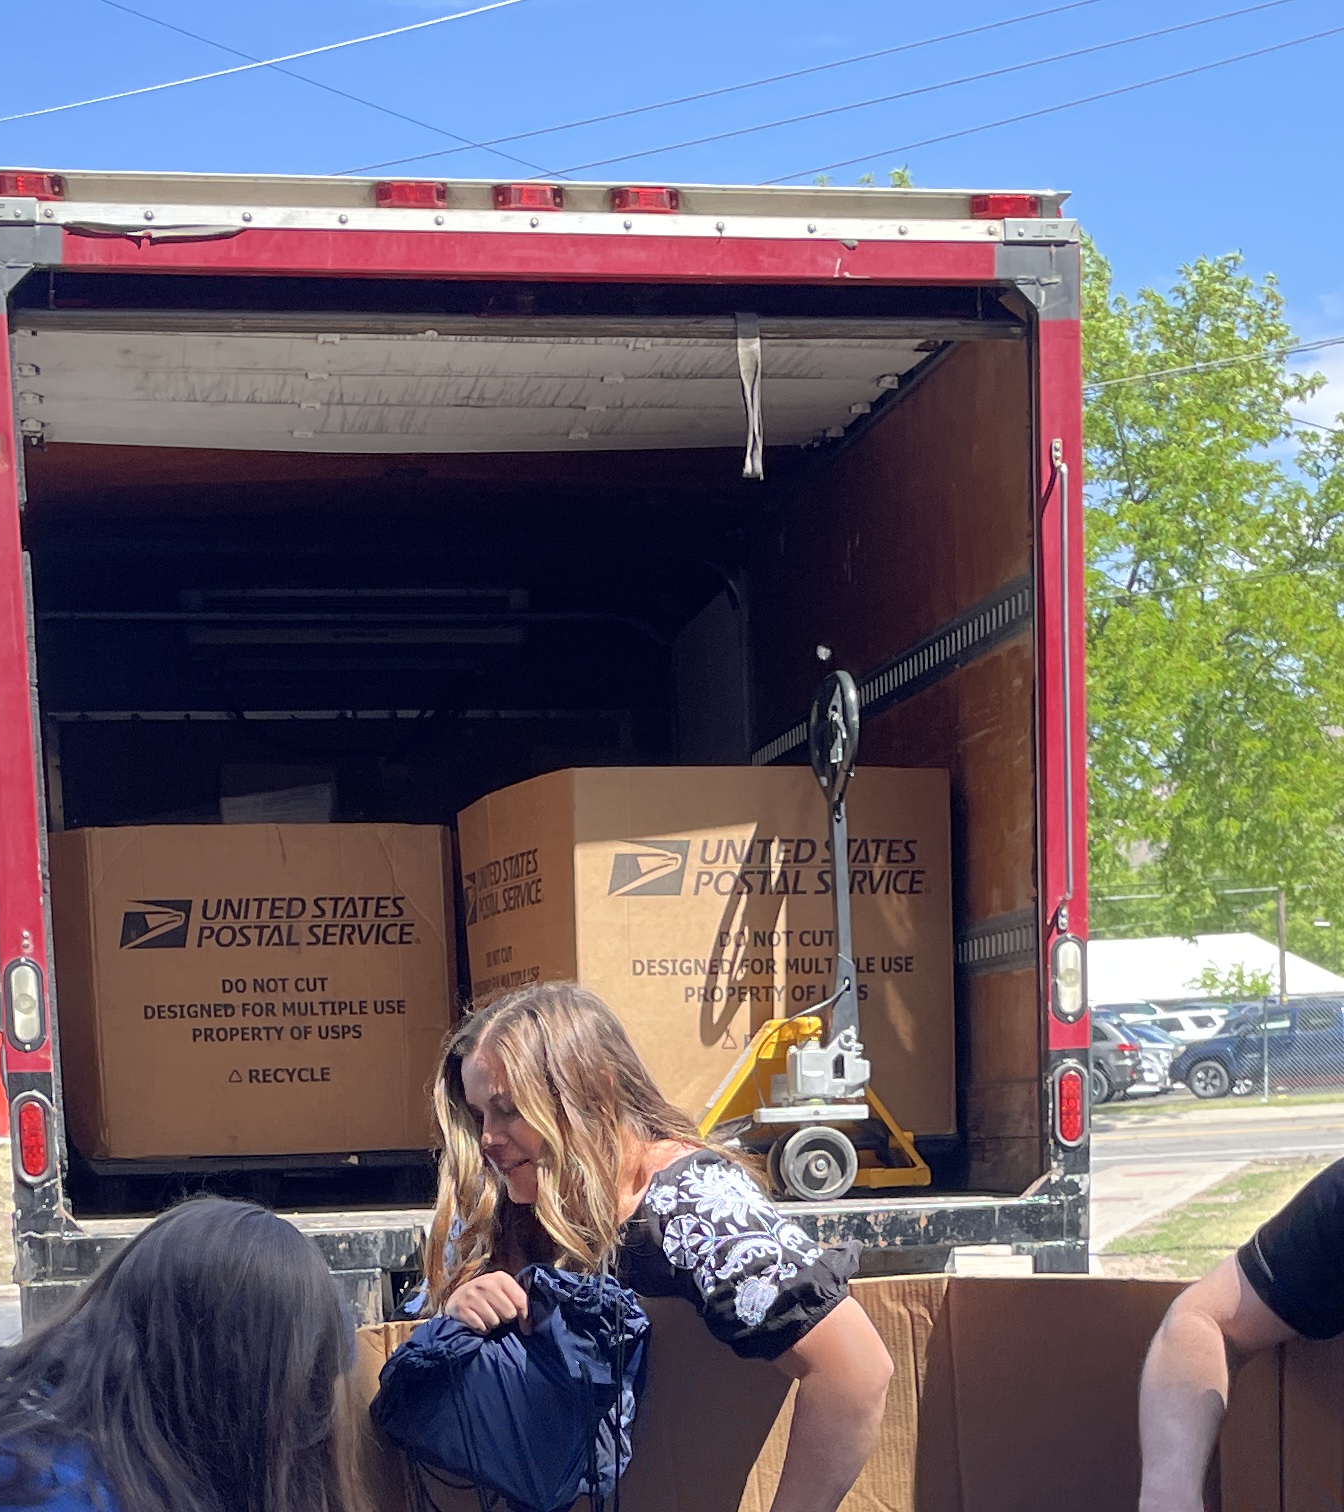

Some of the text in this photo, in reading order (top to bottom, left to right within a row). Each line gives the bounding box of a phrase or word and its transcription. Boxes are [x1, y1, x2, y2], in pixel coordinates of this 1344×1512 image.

[699, 838, 918, 865] UNITED SATES
[504, 848, 538, 882] STATES
[693, 870, 926, 896] POSTAL SRVICE
[503, 878, 543, 913] SERVICE
[201, 895, 405, 921] UNITED STATES
[197, 922, 416, 949] POSTAL SERVICE
[719, 930, 835, 947] DO NOT CUT
[632, 956, 914, 976] DESIGNED FOR MULTLE USE
[221, 977, 328, 994] DO NOT CUT
[684, 986, 785, 1003] PROPERTY
[791, 985, 817, 1001] OF
[143, 1000, 407, 1021] DESIGNED FOR MULTIPLE USE
[192, 1024, 363, 1043] PROPERTY OF USPS
[248, 1067, 331, 1084] RECYCLE
